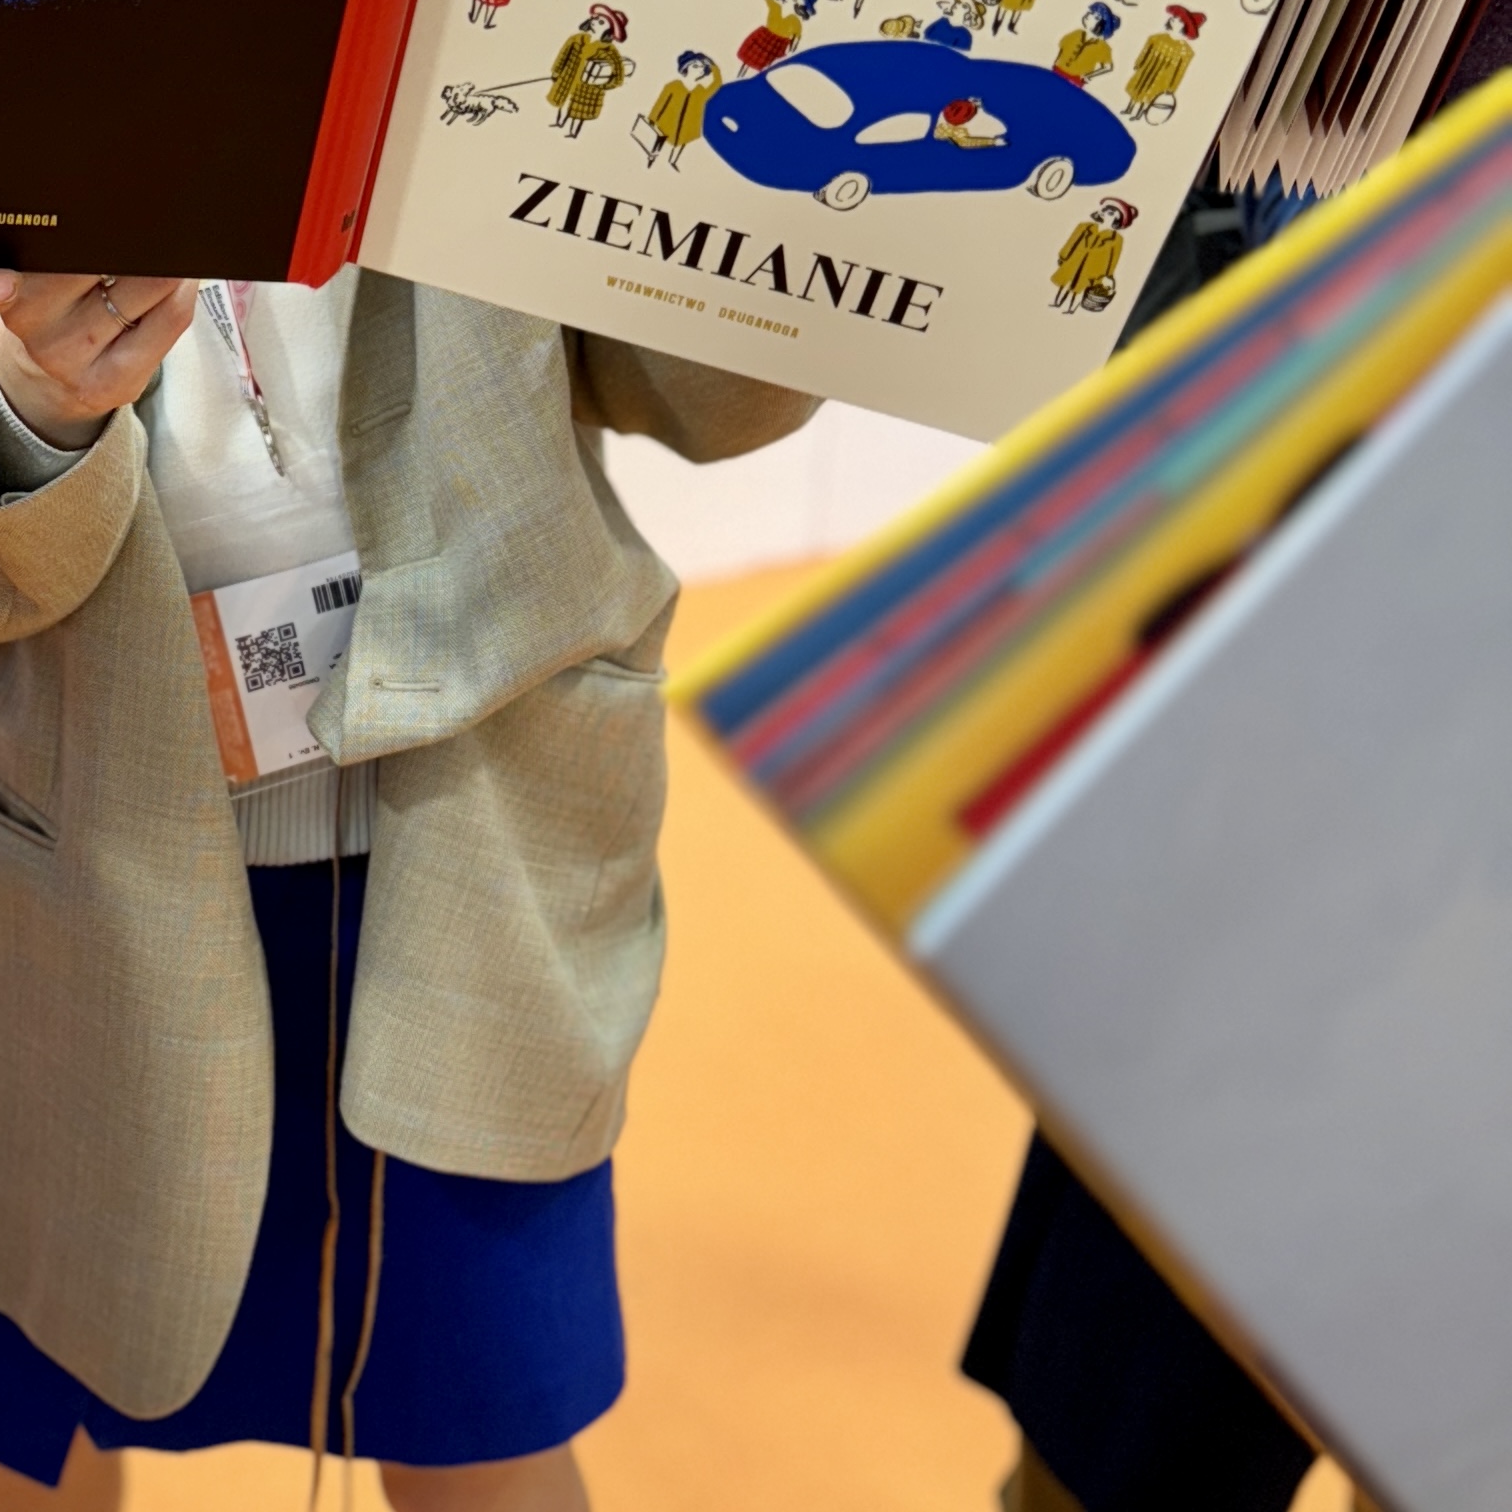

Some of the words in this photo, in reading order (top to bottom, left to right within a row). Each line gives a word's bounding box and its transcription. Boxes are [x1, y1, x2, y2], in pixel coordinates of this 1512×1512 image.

[508, 172, 945, 335] ZIEMIANIE
[606, 274, 706, 314] WYDAWNICTWO
[718, 306, 801, 339] DRUGANOGA
